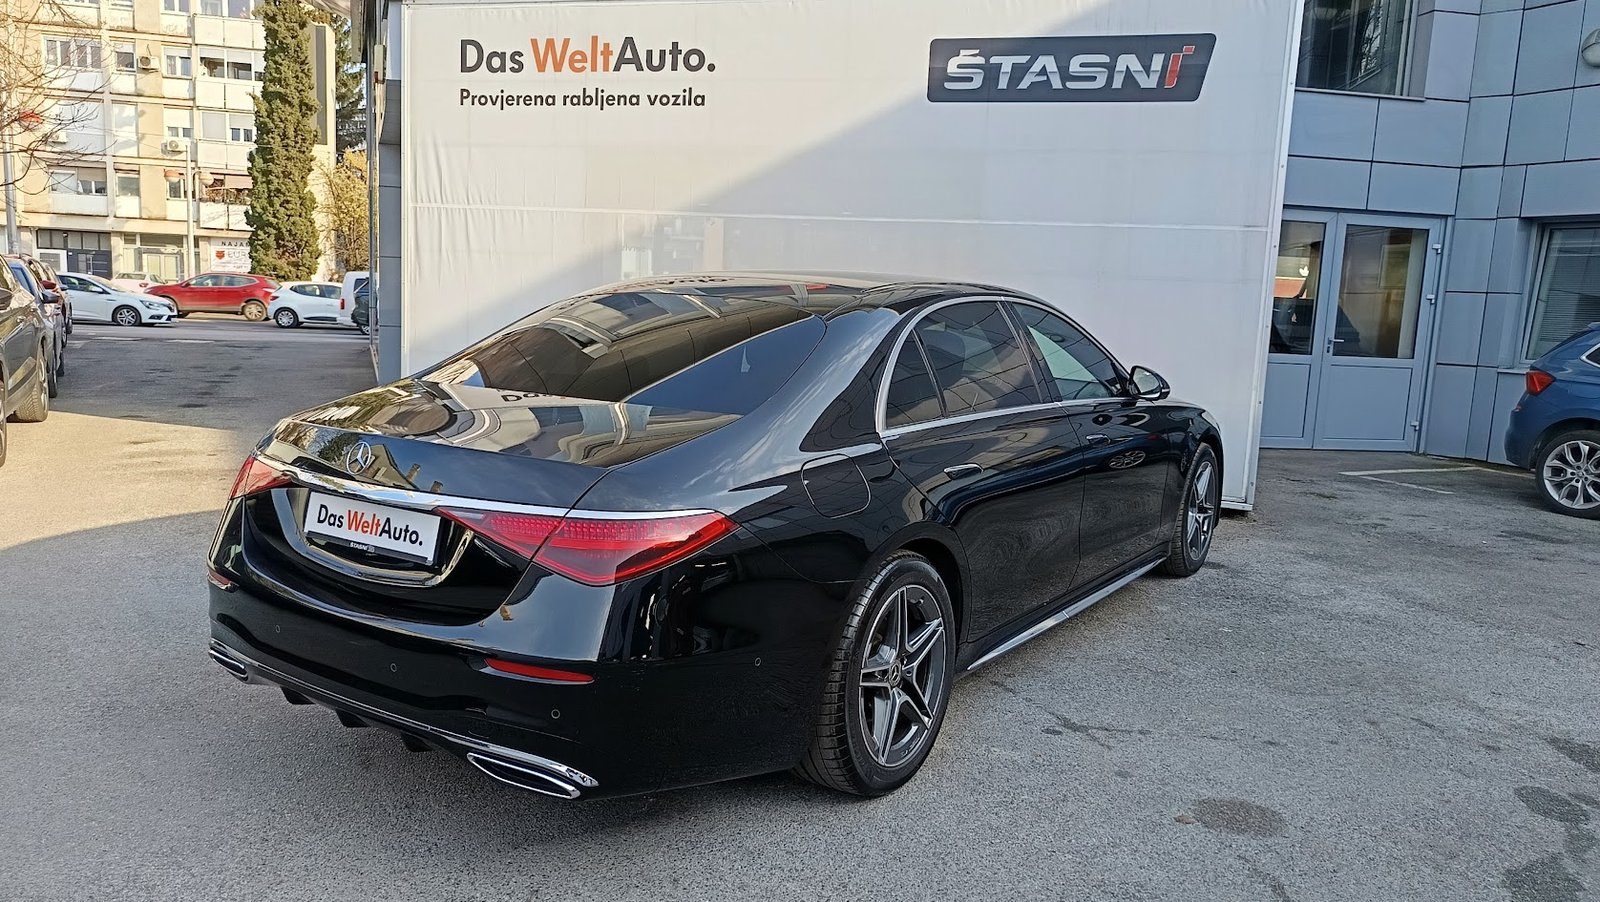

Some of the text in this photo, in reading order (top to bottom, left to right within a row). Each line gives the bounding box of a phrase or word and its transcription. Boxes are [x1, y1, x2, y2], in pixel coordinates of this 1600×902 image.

[460, 35, 716, 73] Das WeltAuto.
[459, 87, 706, 110] Provjerena rabljena vozila
[317, 504, 423, 546] Das WeltAuto.
